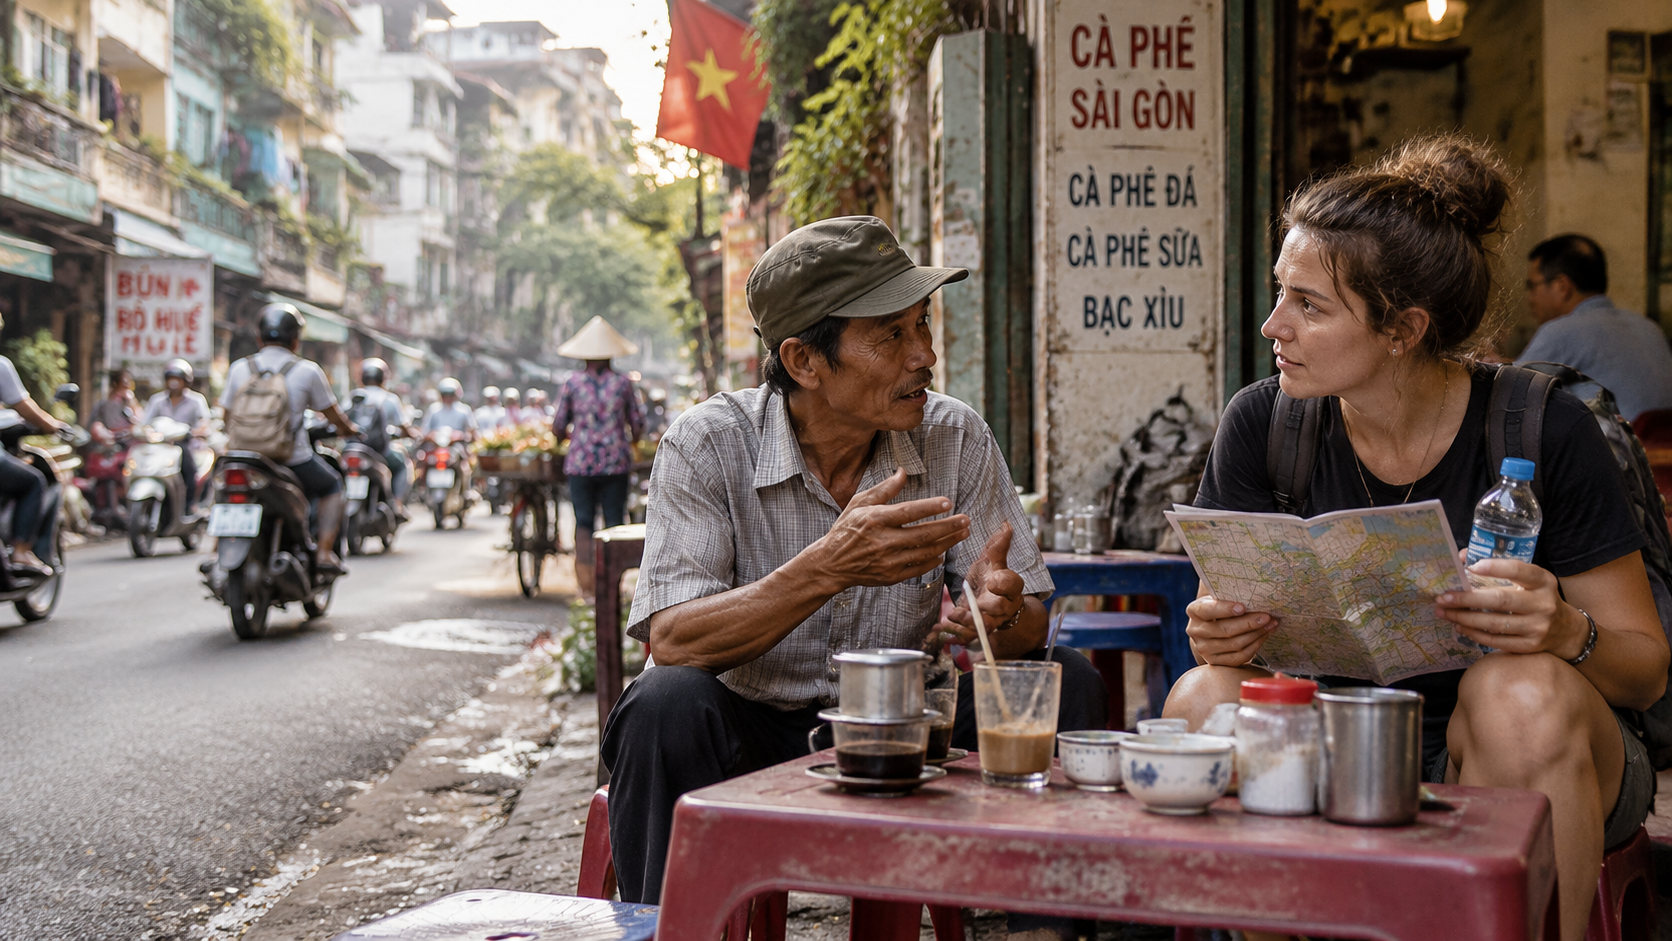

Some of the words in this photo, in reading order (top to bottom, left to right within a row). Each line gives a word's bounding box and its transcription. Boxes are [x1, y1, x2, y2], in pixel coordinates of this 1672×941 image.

[1071, 14, 1116, 69] CÀ
[1071, 79, 1121, 131] SÀI
[1132, 79, 1196, 131] GÒN
[1069, 164, 1100, 208] CÀ
[1165, 164, 1198, 207] ĐÁ
[1068, 225, 1098, 268] CÀ
[1158, 226, 1203, 268] SỮA
[1083, 294, 1133, 337] BẠC
[1143, 286, 1185, 329] XÌU
